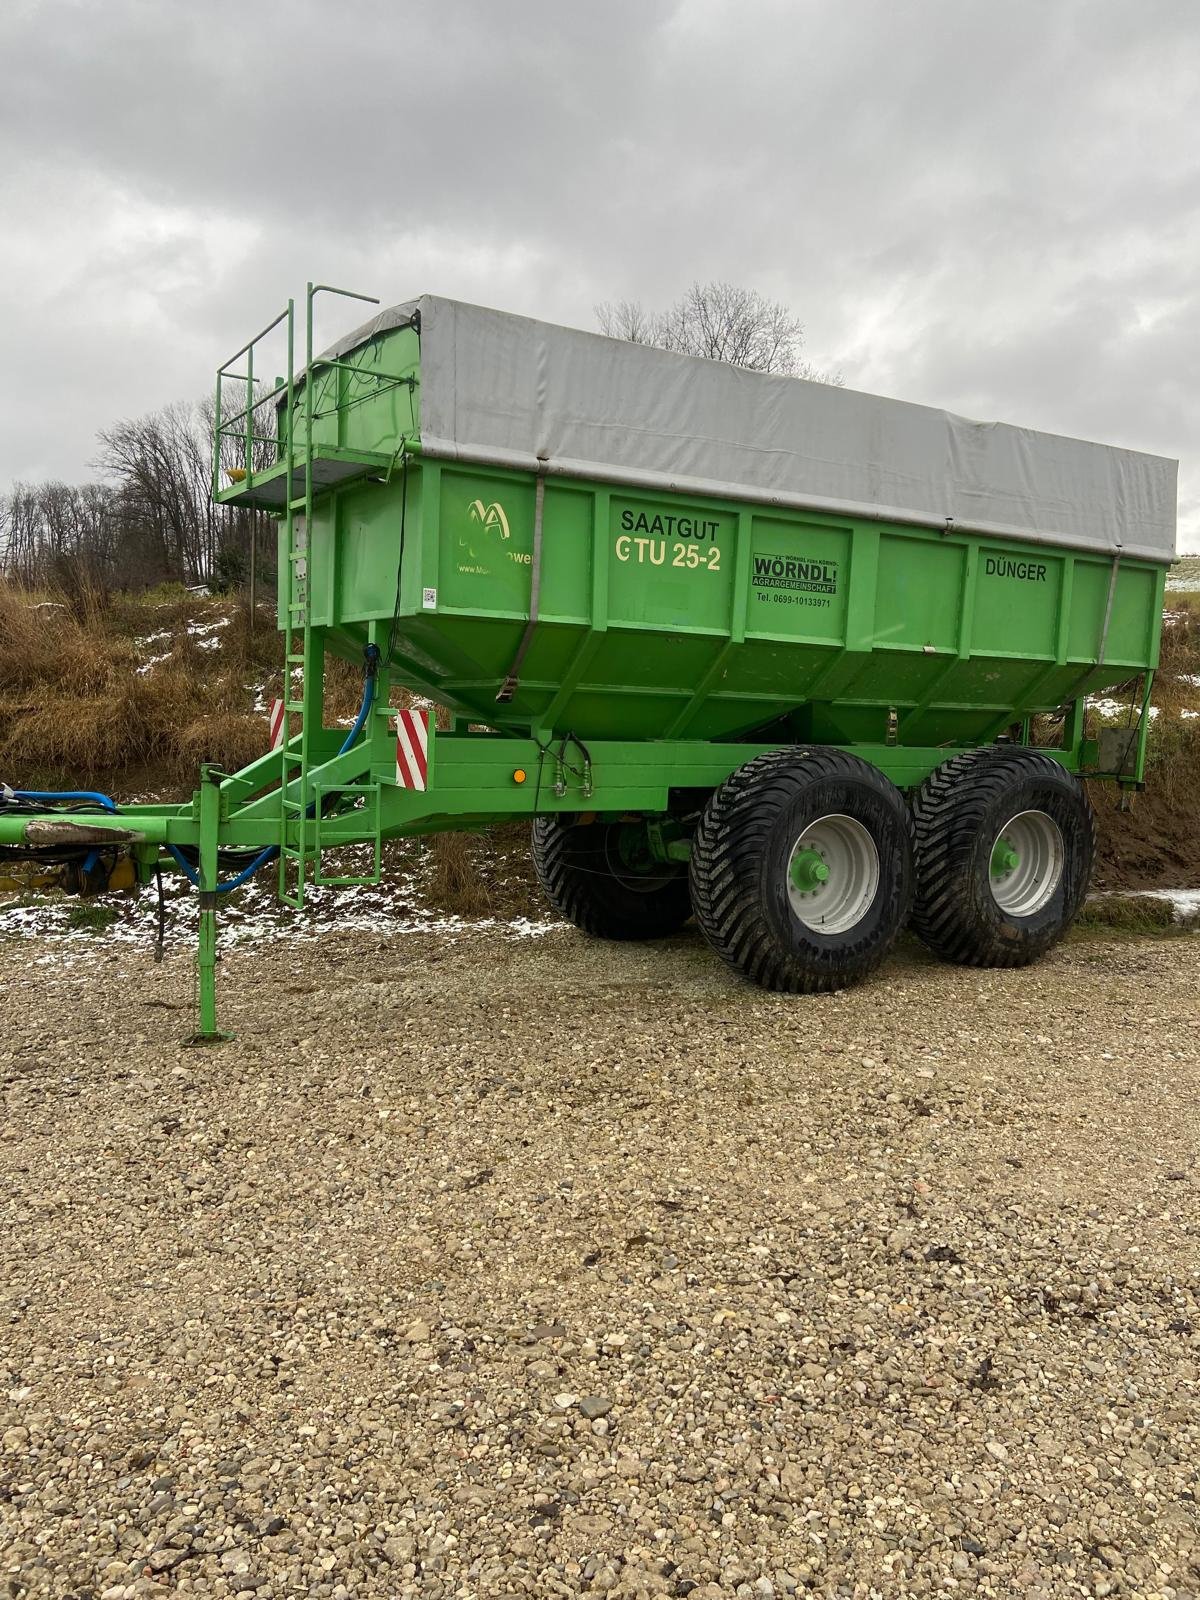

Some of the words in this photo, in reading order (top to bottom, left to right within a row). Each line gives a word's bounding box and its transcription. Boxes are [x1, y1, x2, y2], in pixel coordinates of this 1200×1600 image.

[621, 510, 719, 541] SAATGUT
[672, 543, 721, 571] 25-2
[754, 556, 836, 582] WÖRNDL!
[985, 556, 1047, 582] DÜNGER
[752, 577, 836, 593] AGRARGEMEINSCHAFT
[757, 593, 771, 602] Tel.
[773, 594, 831, 608] 0699-10133971
